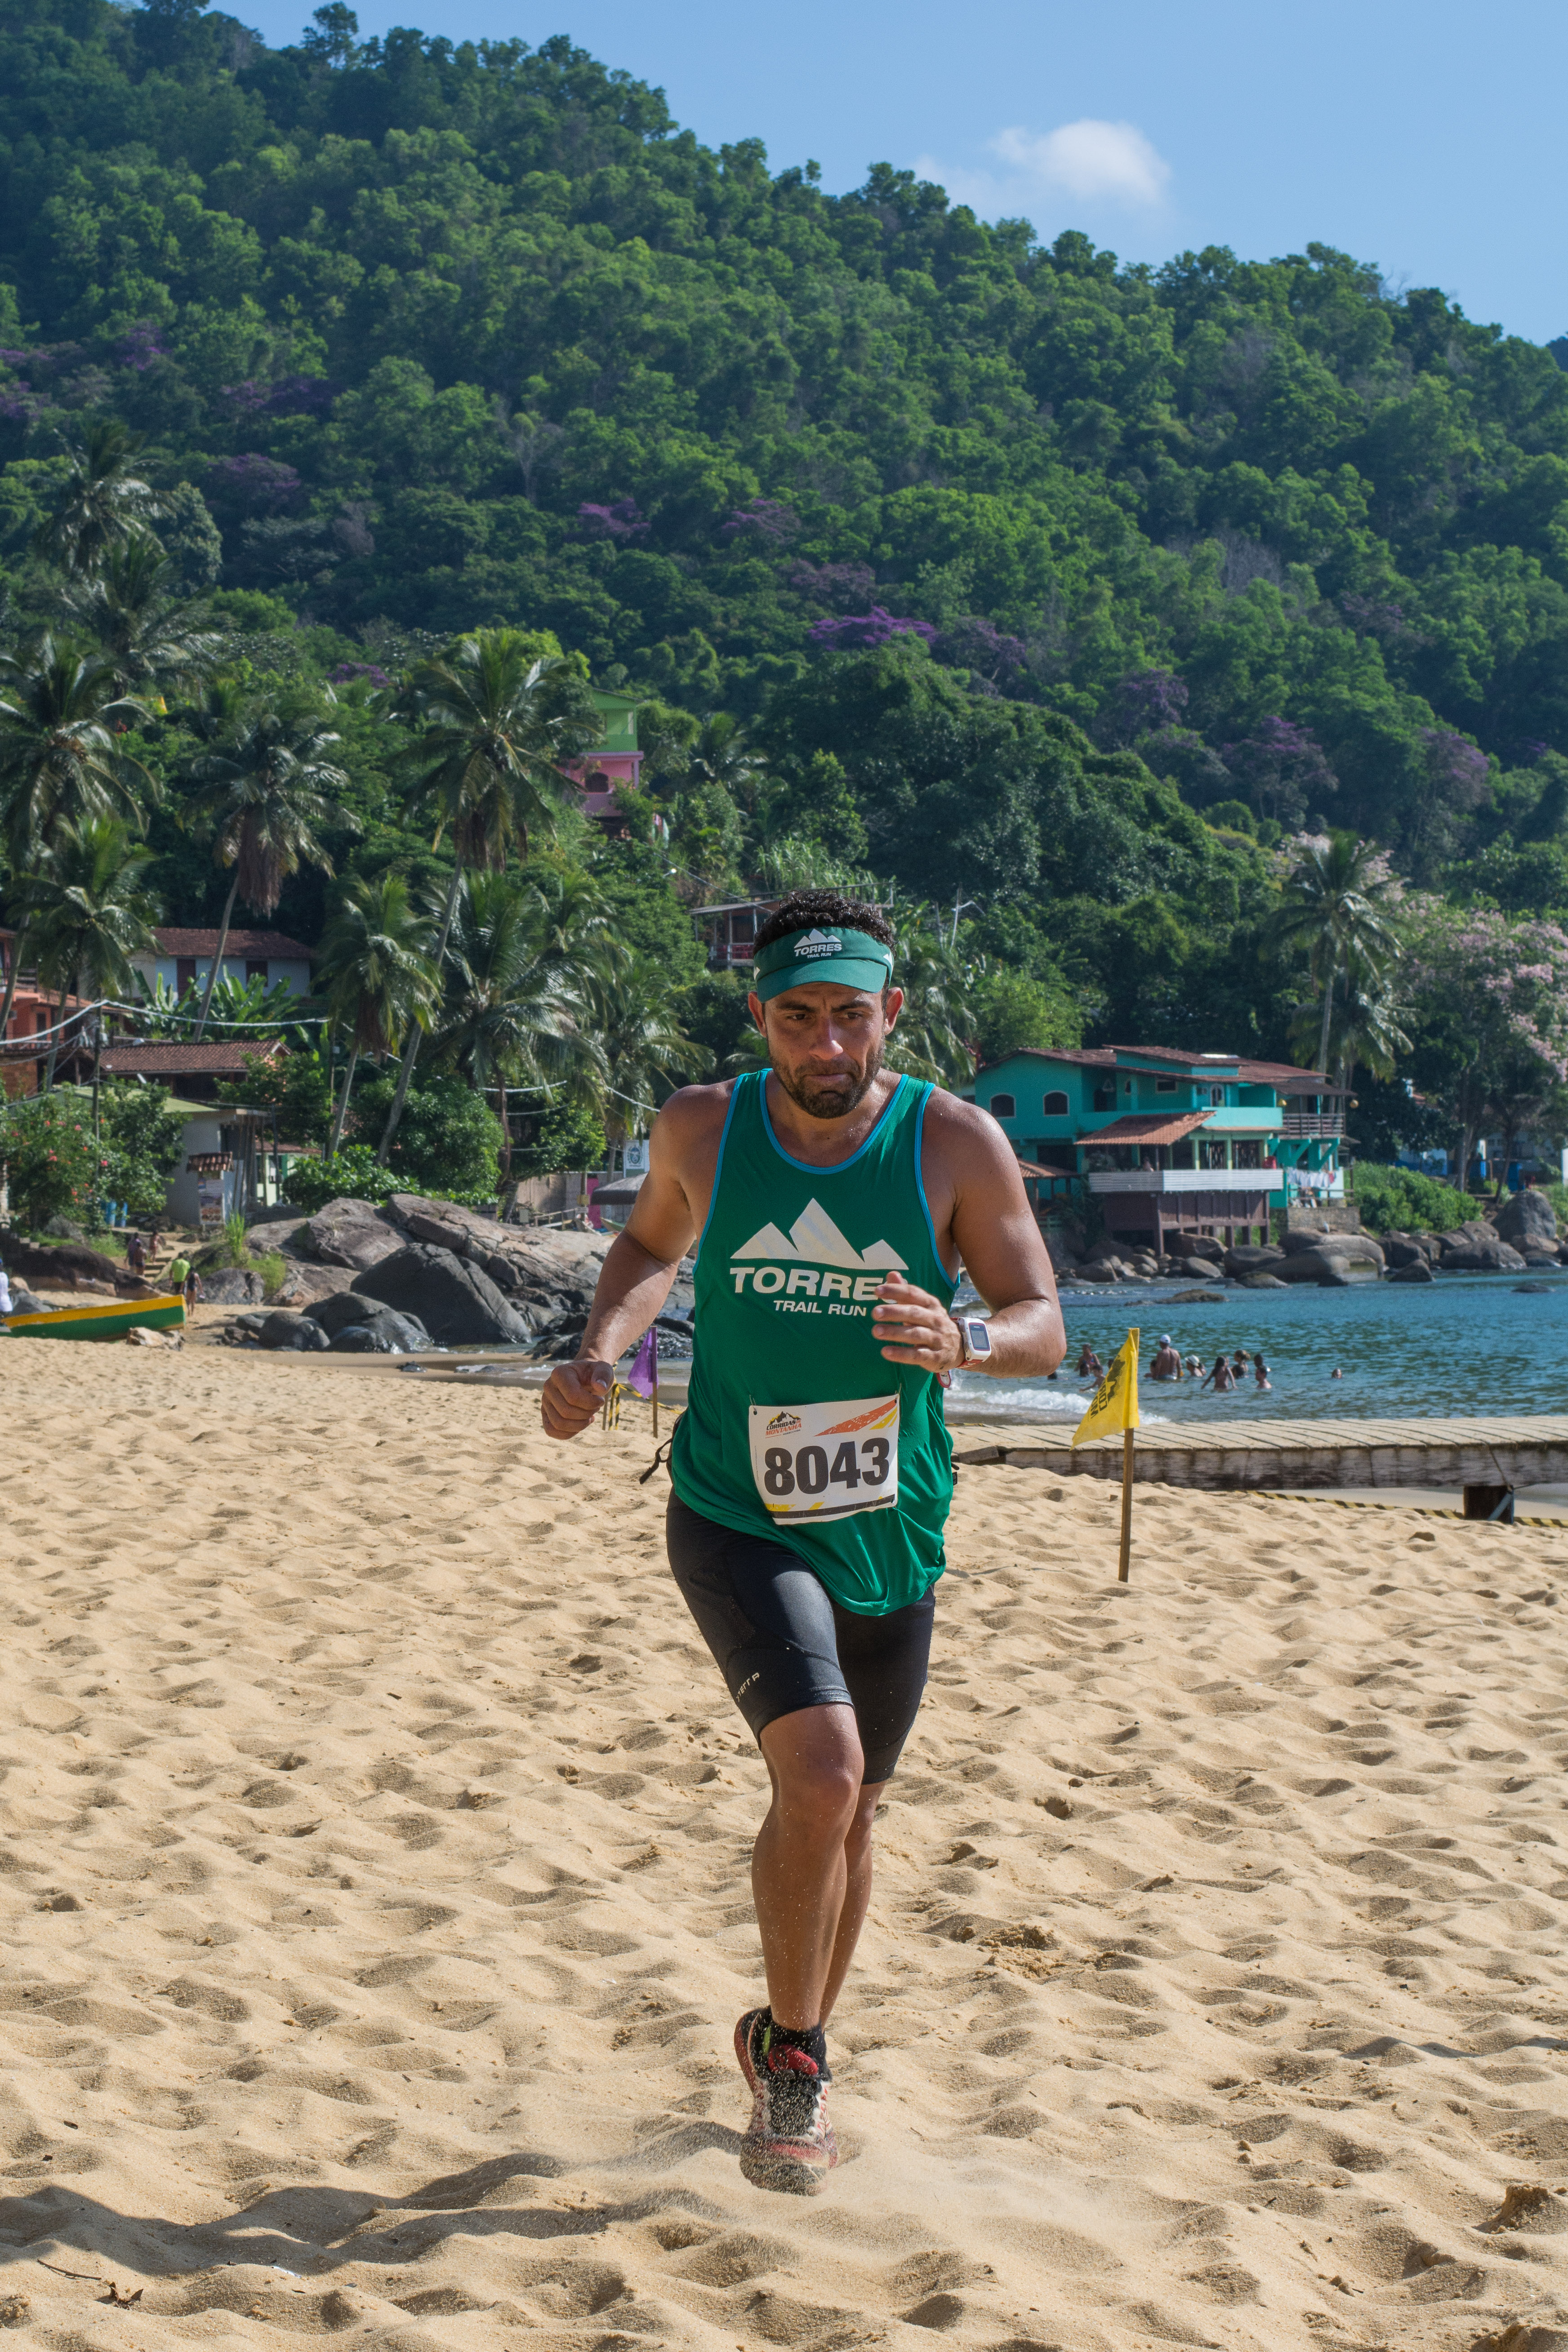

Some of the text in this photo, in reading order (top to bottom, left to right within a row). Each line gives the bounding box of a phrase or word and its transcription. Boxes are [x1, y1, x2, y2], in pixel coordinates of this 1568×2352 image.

[794, 944, 842, 957] TORRES
[774, 1300, 867, 1316] TRAIL RUN
[766, 1420, 796, 1430] CORRIDAS
[766, 1423, 802, 1436] MONTANHA
[764, 1438, 890, 1496] 8043
